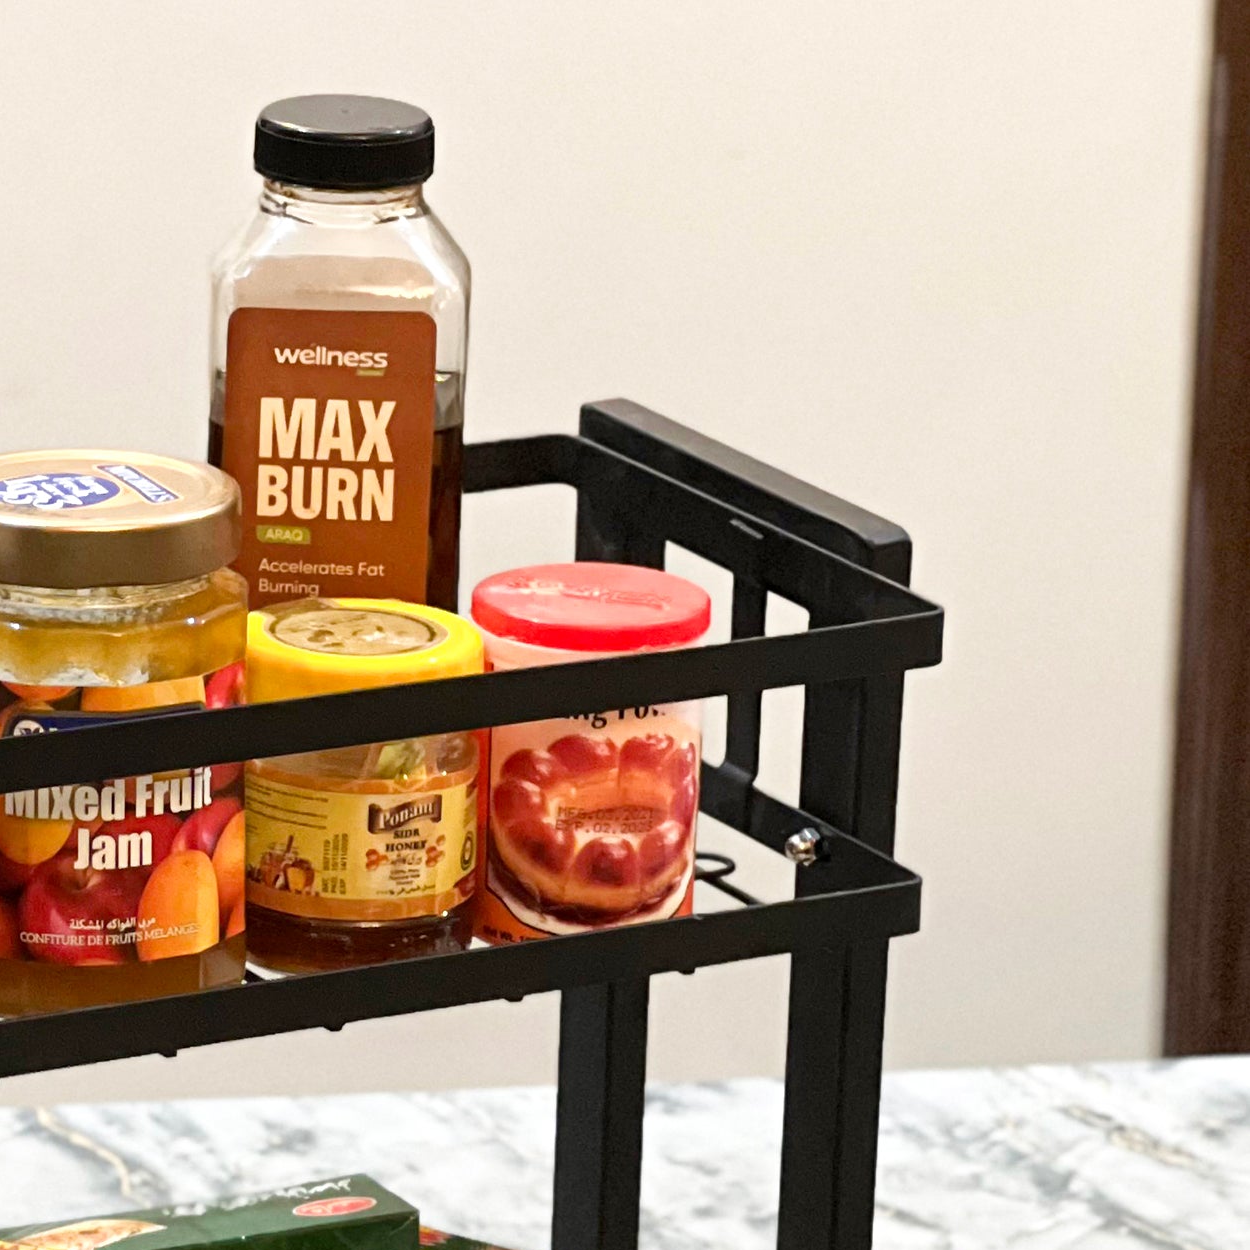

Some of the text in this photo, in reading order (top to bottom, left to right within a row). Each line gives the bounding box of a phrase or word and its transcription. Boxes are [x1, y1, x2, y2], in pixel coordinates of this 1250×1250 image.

[274, 346, 388, 369] wellness
[258, 397, 397, 462] MAX
[256, 464, 395, 522] BURN
[258, 558, 385, 577] Accelerates Fat
[258, 577, 320, 598] Burning
[4, 778, 126, 822] Mixed
[135, 766, 213, 818] Fruit
[74, 827, 153, 871] Jam
[20, 931, 85, 946] CONFITURE
[87, 934, 104, 947] DE
[105, 931, 143, 946] FRUITS
